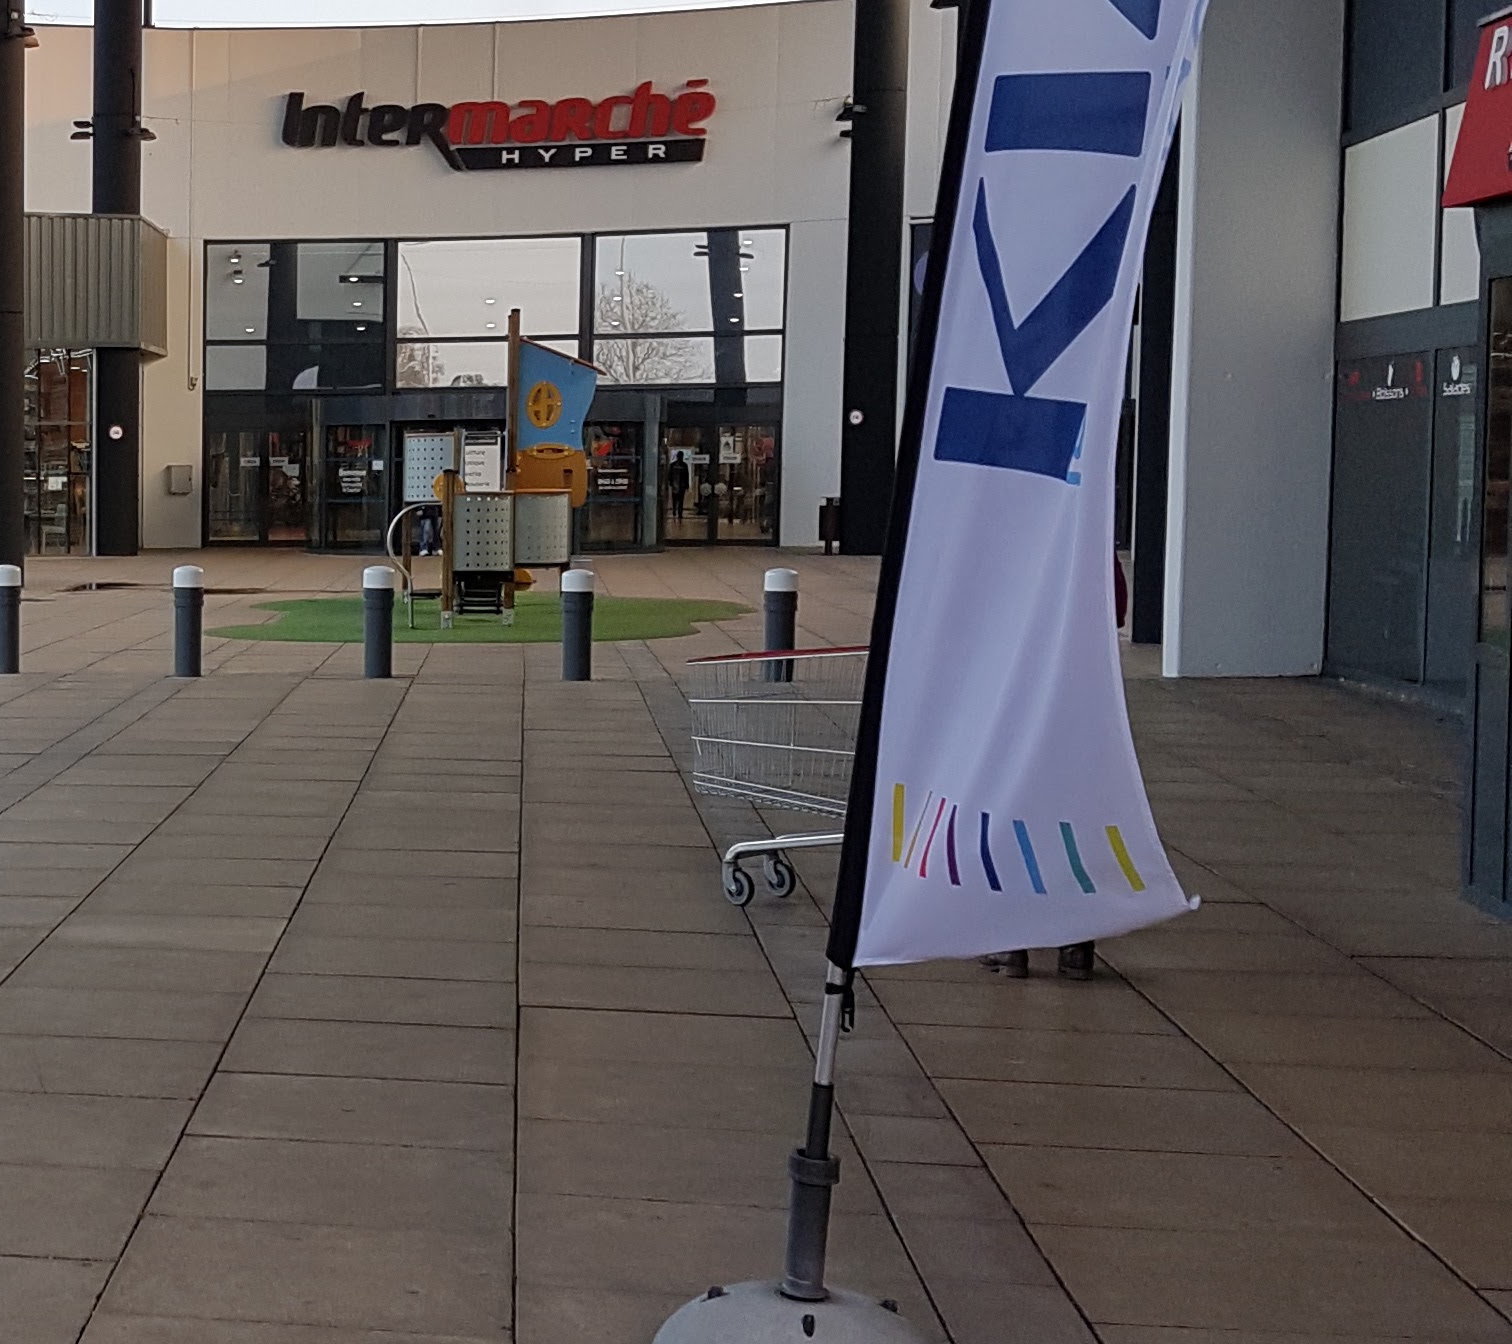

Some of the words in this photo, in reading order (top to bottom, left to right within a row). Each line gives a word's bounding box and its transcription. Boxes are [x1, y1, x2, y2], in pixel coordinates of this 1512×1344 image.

[1484, 25, 1512, 90] R
[282, 80, 717, 173] Intermarché
[501, 143, 667, 164] HYPER
